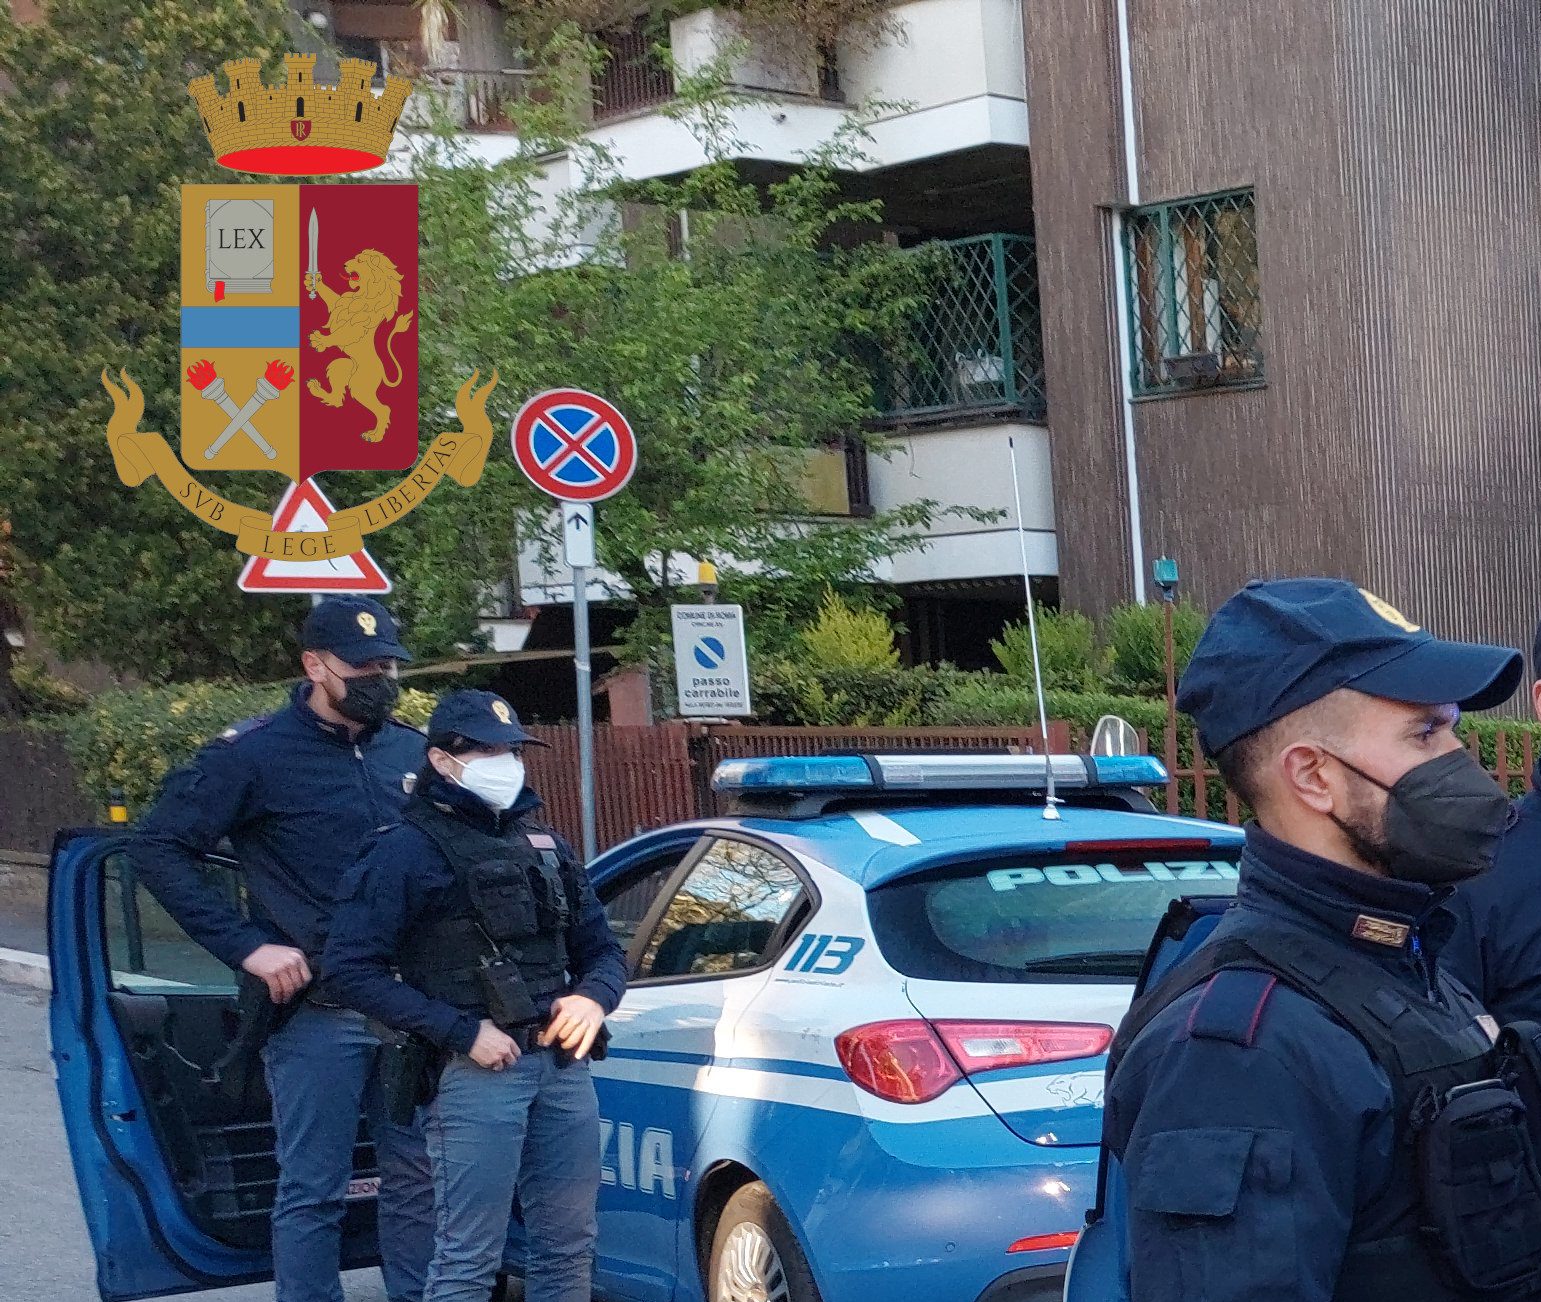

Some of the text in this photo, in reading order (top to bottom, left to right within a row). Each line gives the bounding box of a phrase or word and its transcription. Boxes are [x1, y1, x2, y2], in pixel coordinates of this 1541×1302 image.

[684, 687, 741, 699] carrabile
[692, 677, 731, 688] passo
[985, 860, 1241, 892] POLIZI
[783, 933, 866, 976] 113
